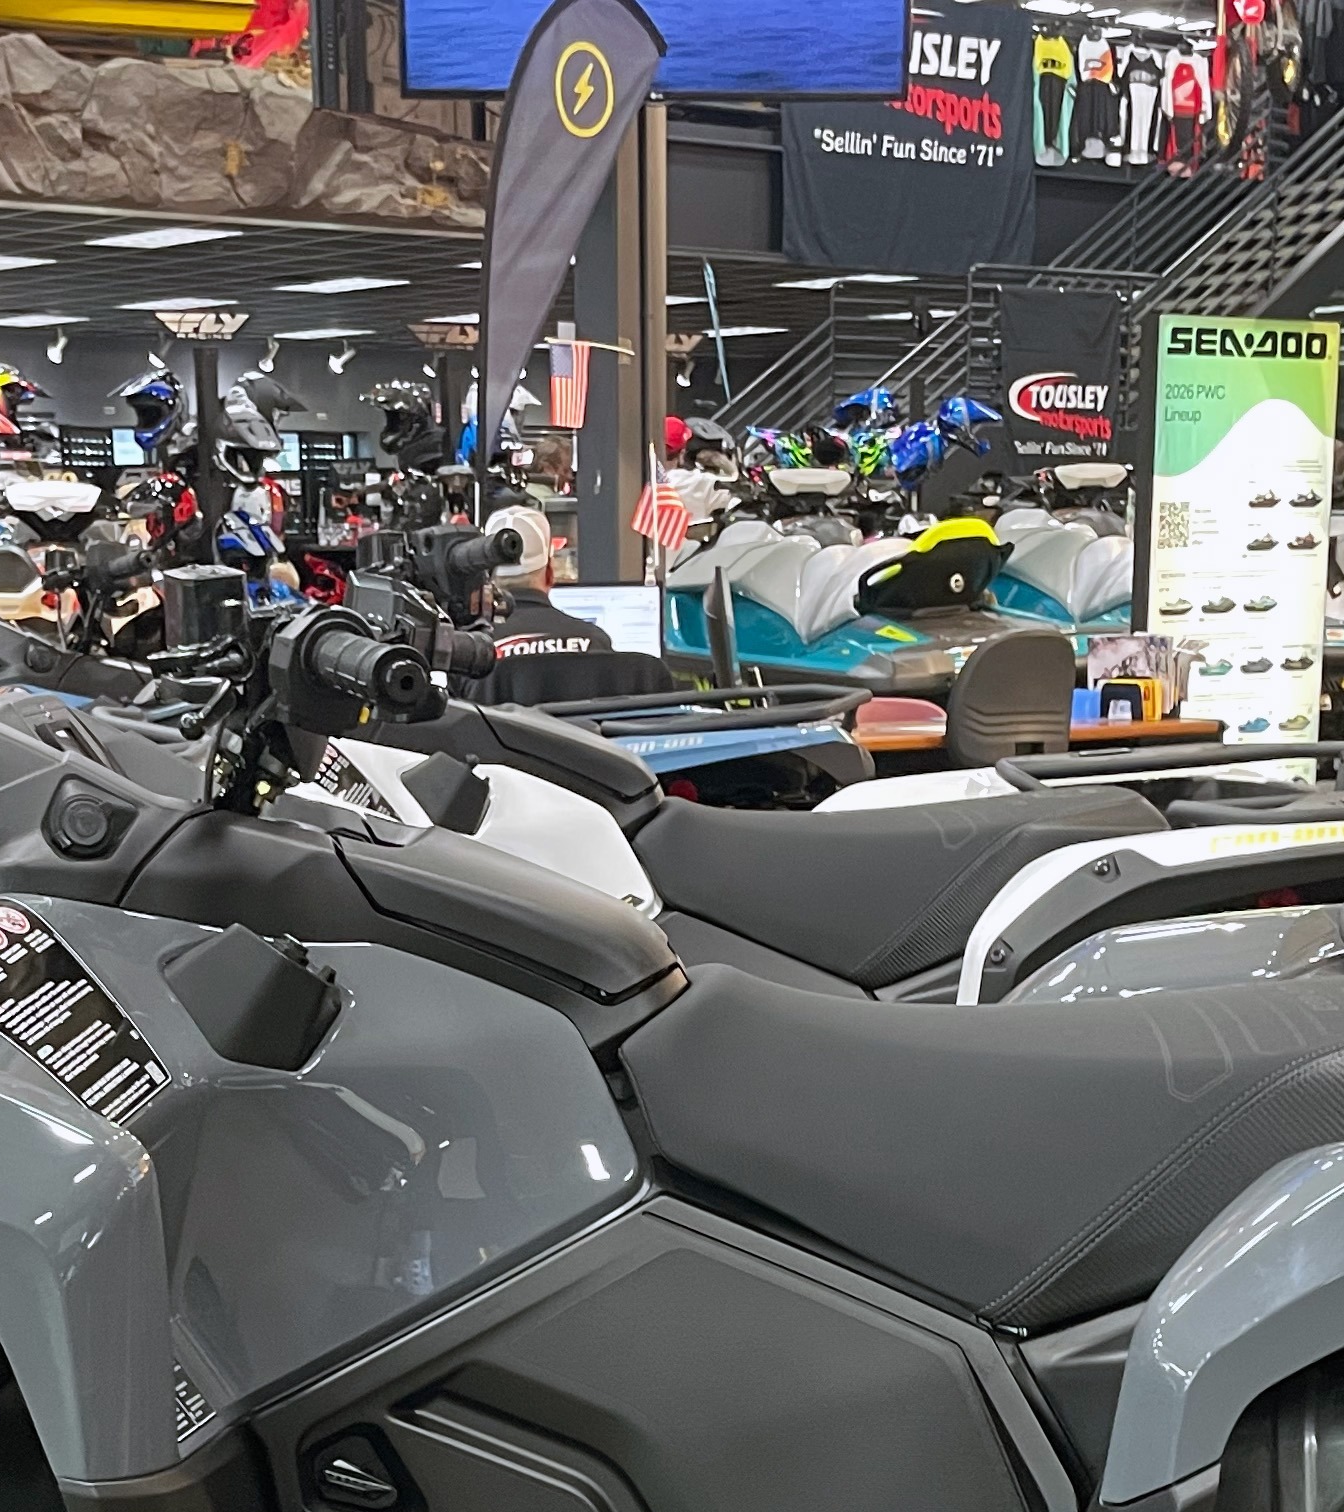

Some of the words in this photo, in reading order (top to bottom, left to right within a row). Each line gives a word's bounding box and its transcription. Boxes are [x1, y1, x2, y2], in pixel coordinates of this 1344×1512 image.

[909, 30, 1002, 85] SLEY
[881, 134, 916, 160] Fun
[919, 139, 967, 165] Since
[1028, 384, 1109, 412] TOUSLEY
[1165, 383, 1194, 400] 2026
[1196, 384, 1226, 400] PWC
[1164, 405, 1203, 425] Lineup
[503, 637, 591, 657] TOUSLEY
